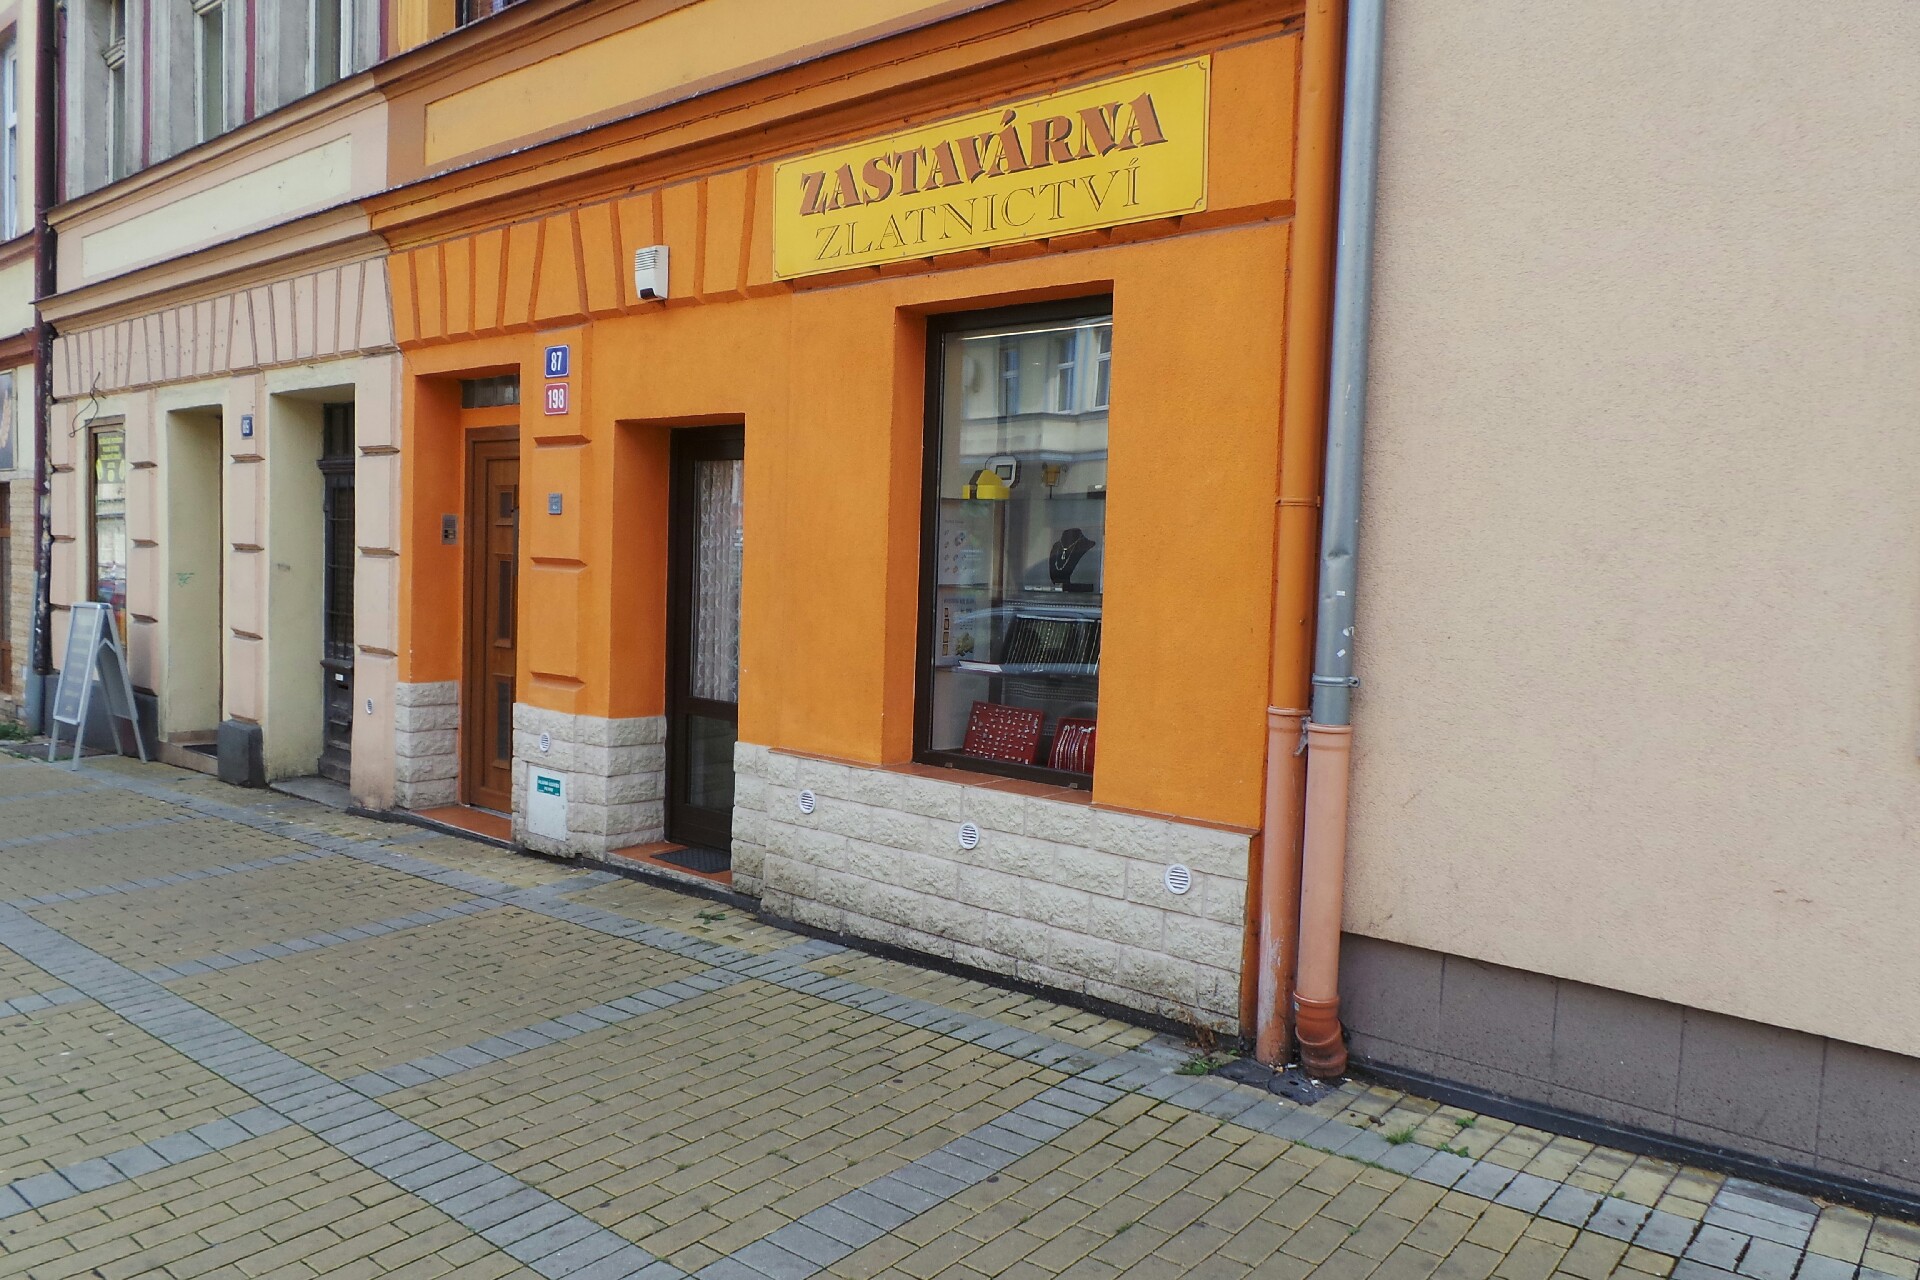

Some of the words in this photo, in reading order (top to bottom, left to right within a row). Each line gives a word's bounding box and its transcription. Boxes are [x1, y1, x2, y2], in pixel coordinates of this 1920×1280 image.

[799, 92, 1168, 217] ZASTAVÁRNA
[814, 157, 1141, 261] ZLATNICTVÍ
[551, 352, 562, 371] 87
[548, 388, 564, 408] 198
